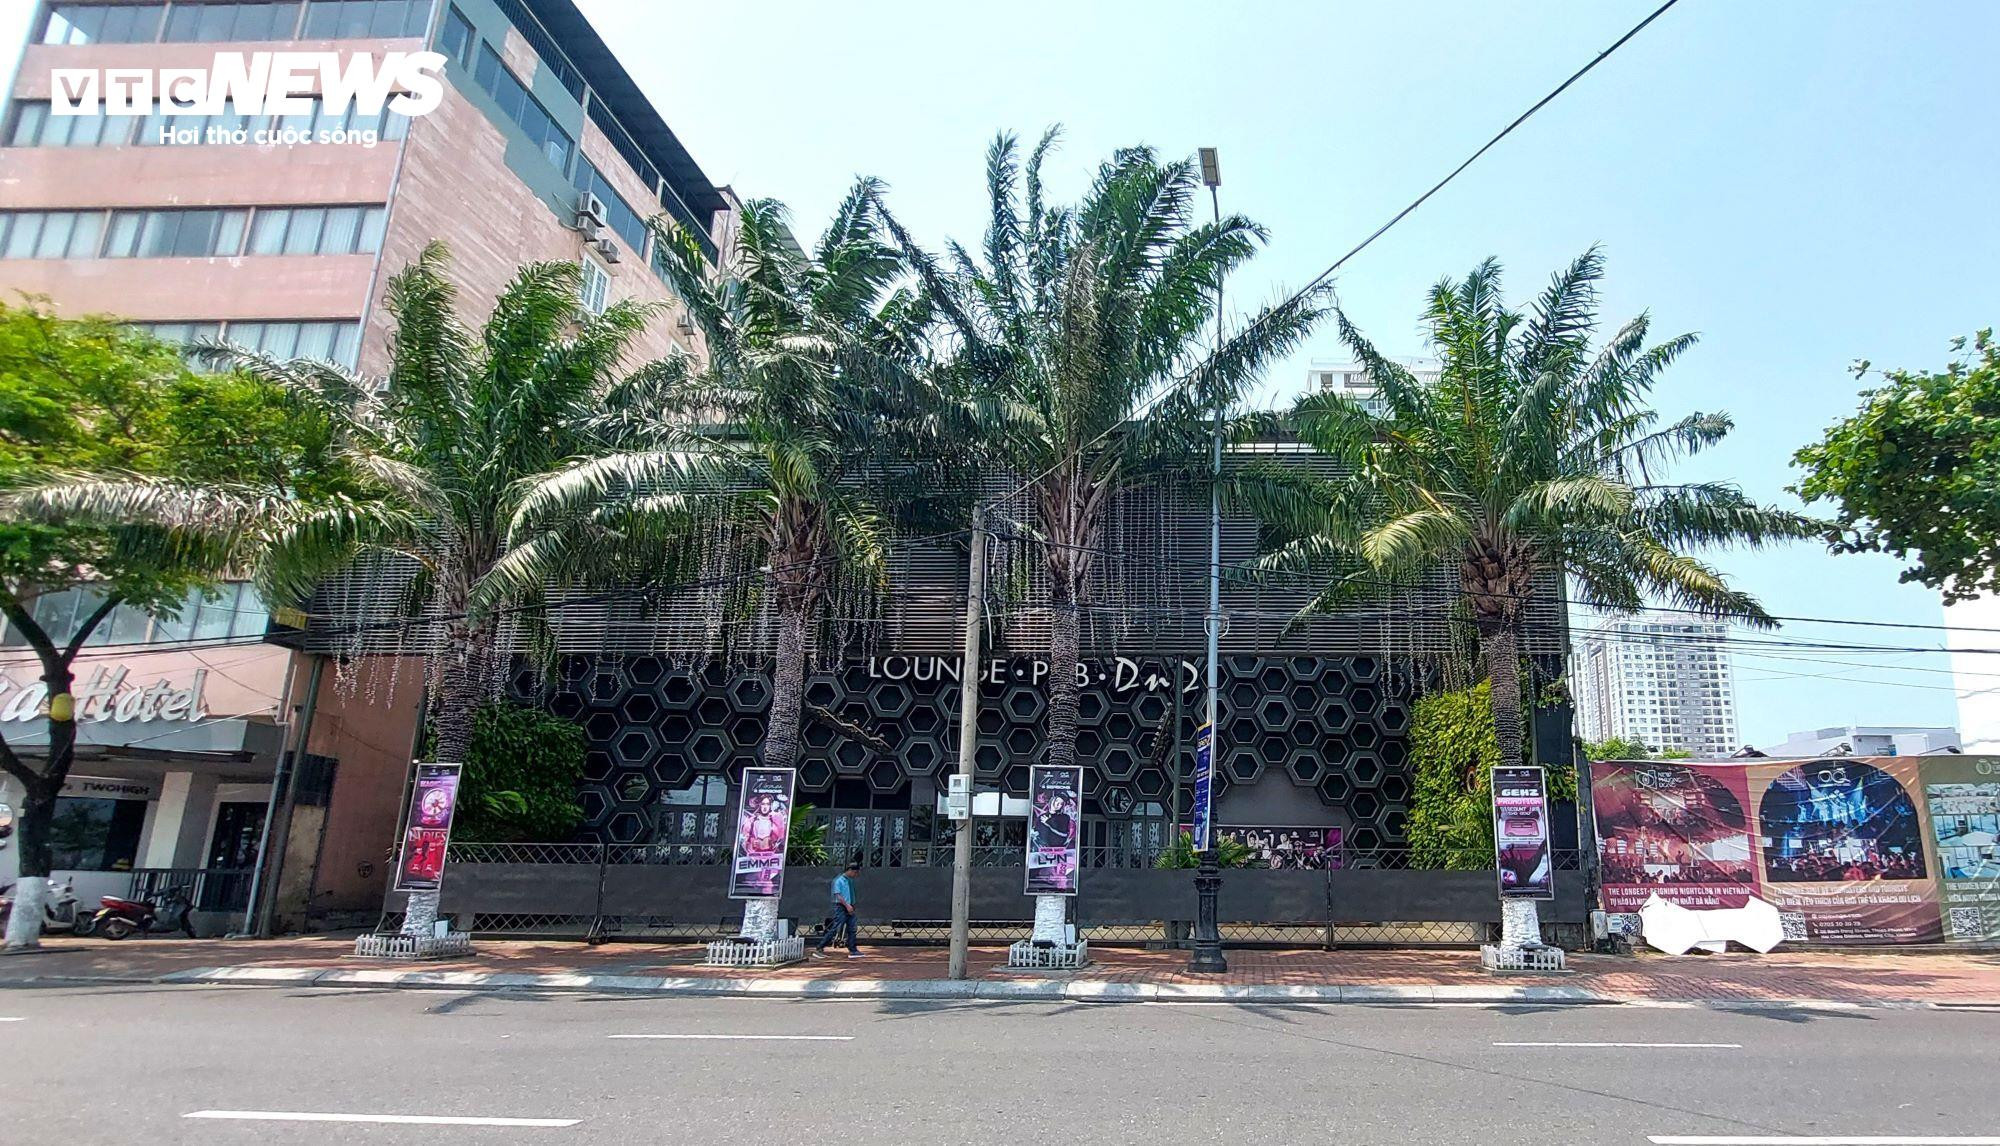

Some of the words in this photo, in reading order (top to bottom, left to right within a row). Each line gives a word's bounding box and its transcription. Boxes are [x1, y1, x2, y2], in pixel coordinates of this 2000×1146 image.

[869, 656, 1005, 684] LOUNE
[1033, 661, 1090, 687] PB
[75, 664, 210, 722] Hotel
[83, 782, 150, 795] TWOHIGH
[739, 858, 780, 870] EMMA
[1038, 854, 1067, 866] LYN
[1608, 888, 1620, 896] THE
